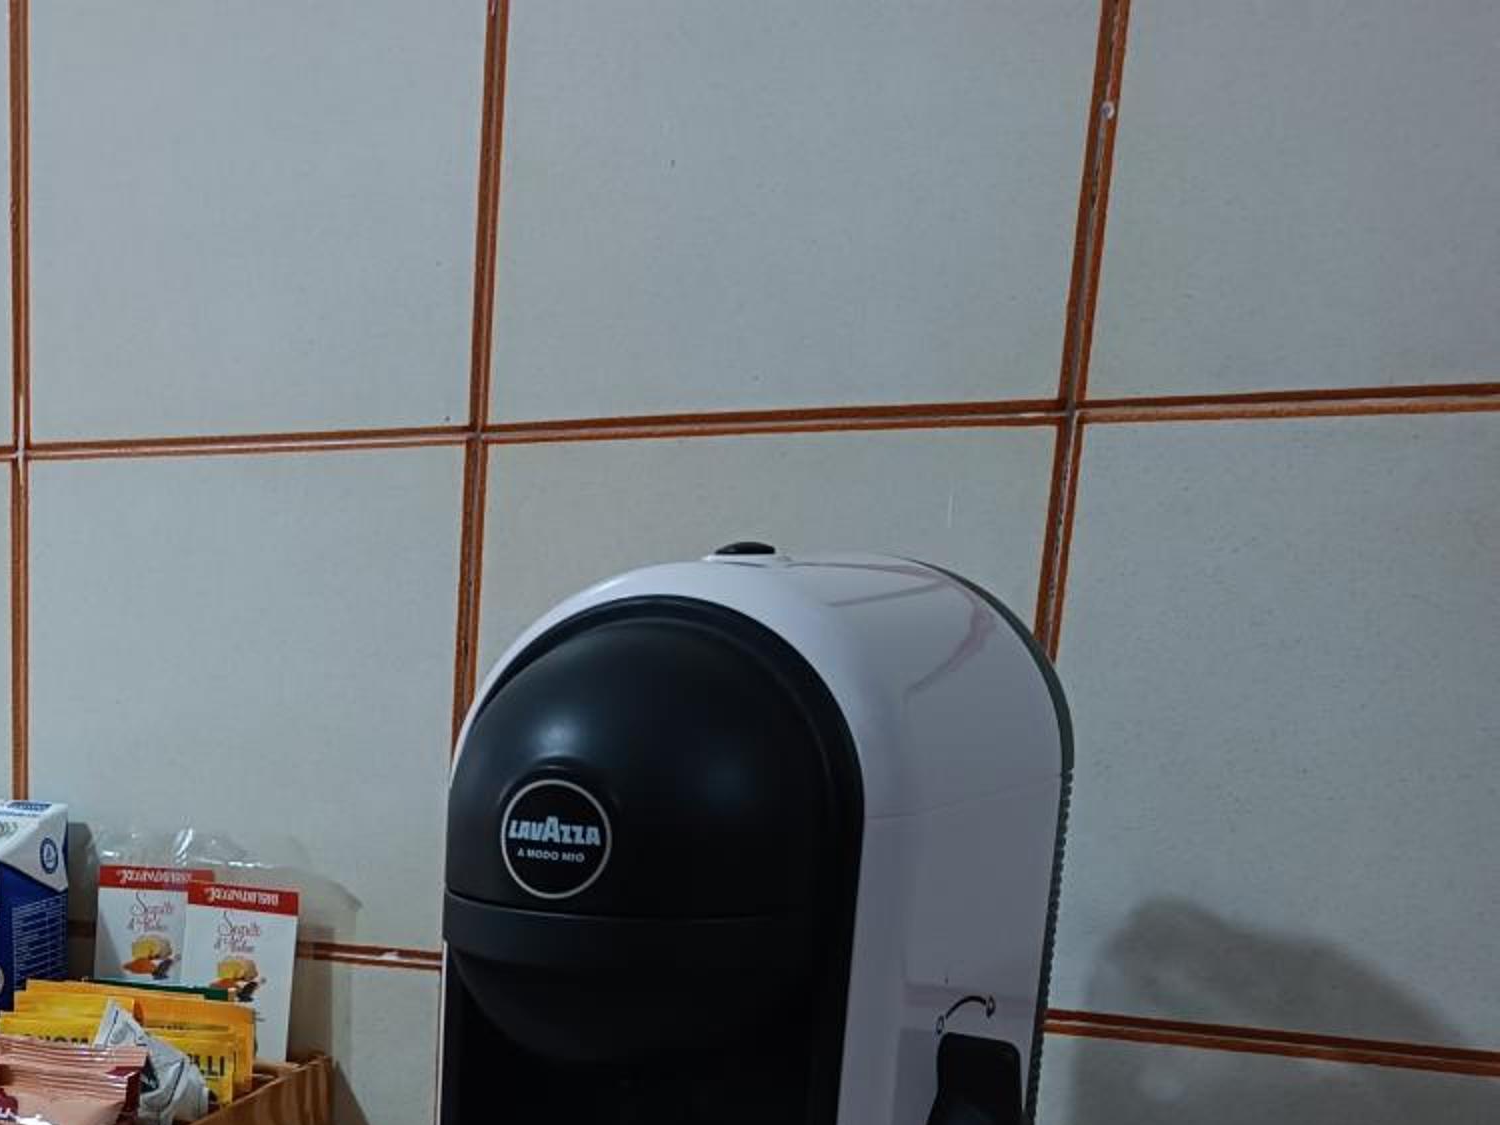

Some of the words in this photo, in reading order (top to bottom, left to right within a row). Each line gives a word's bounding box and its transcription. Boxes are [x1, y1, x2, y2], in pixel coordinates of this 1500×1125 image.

[508, 815, 601, 846] LAVAZZA
[517, 848, 525, 857] A
[527, 849, 559, 861] MODO
[561, 852, 585, 862] MIO
